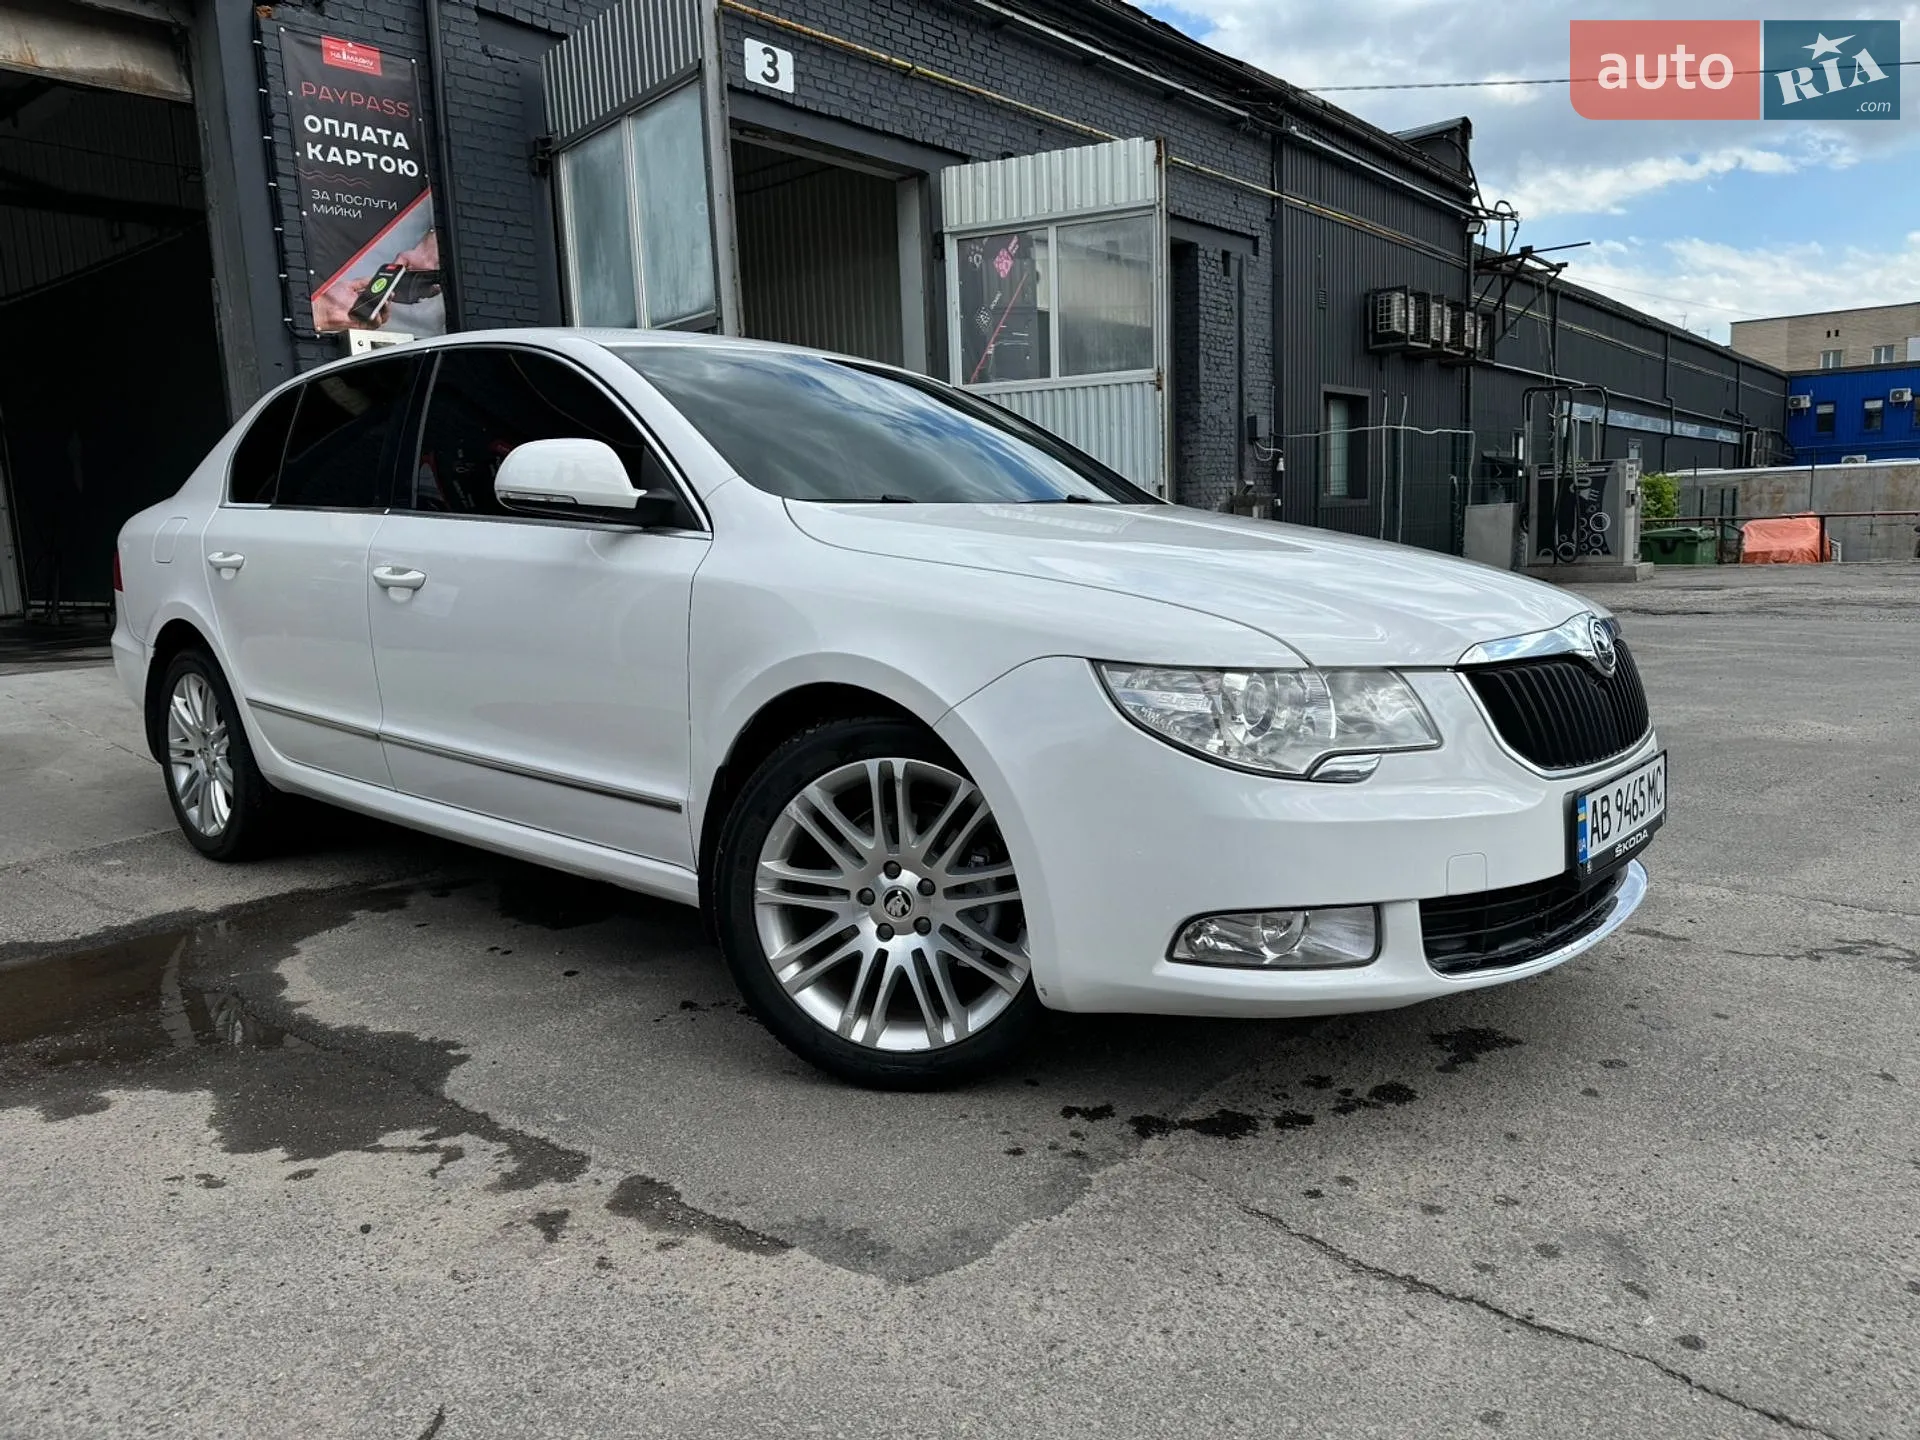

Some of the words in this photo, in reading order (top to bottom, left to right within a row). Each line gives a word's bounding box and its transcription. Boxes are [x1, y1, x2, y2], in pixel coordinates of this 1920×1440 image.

[761, 46, 780, 84] 3
[301, 81, 410, 118] PAYPASS
[303, 114, 410, 151] ОПЛАТА
[306, 142, 419, 177] КАРТОЮ
[311, 189, 331, 201] ЗА
[335, 192, 398, 211] ПОСЛУГИ
[312, 202, 362, 219] МИЙКИ
[1590, 794, 1612, 848] AB
[1615, 774, 1646, 833] 9465
